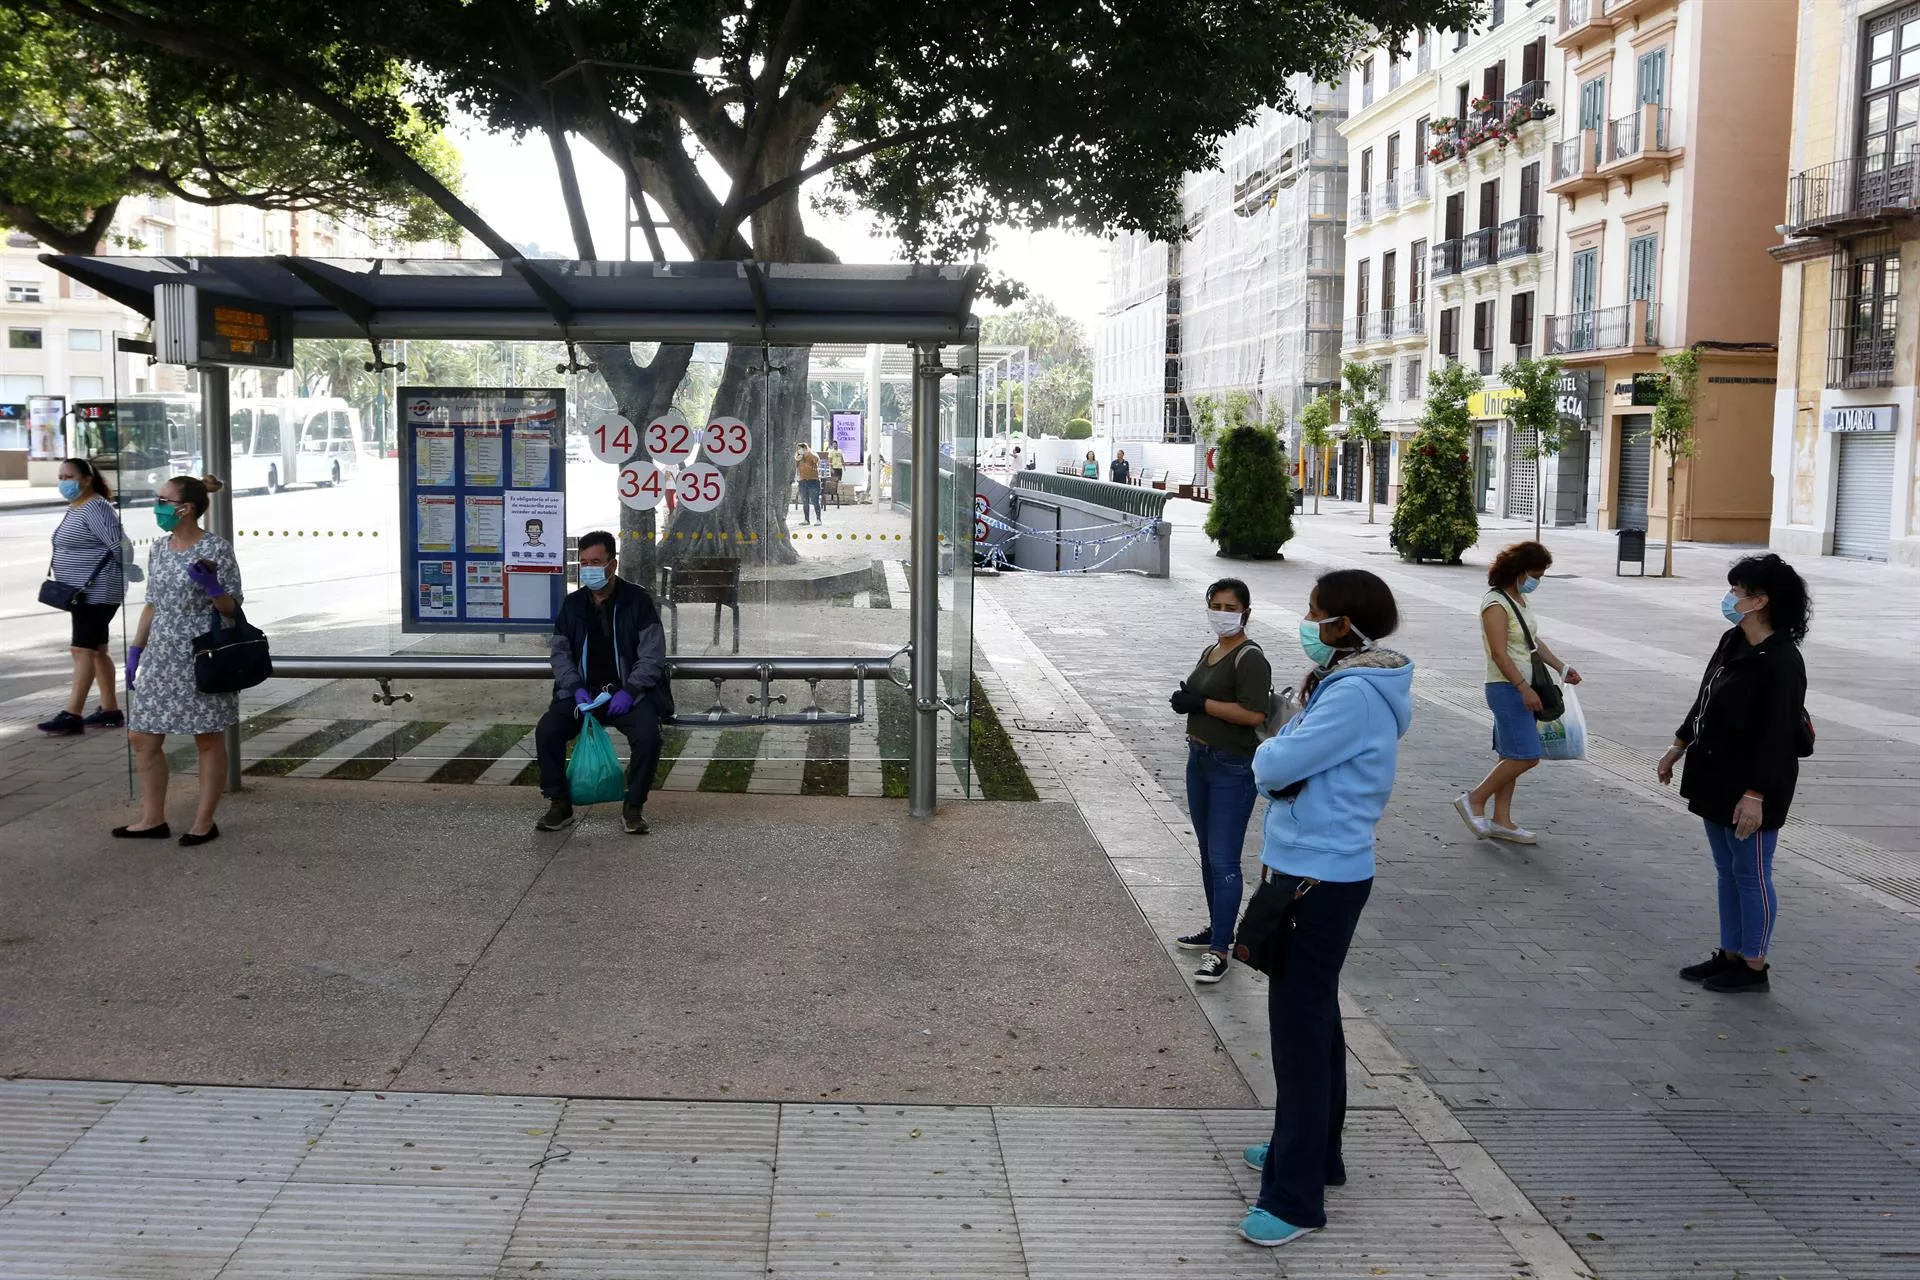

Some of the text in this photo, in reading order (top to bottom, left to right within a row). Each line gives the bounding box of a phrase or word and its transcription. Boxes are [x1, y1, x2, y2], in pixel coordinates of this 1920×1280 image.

[1555, 395, 1583, 419] NECIA
[594, 424, 748, 454] 14 32 33
[620, 469, 721, 502] 34 35
